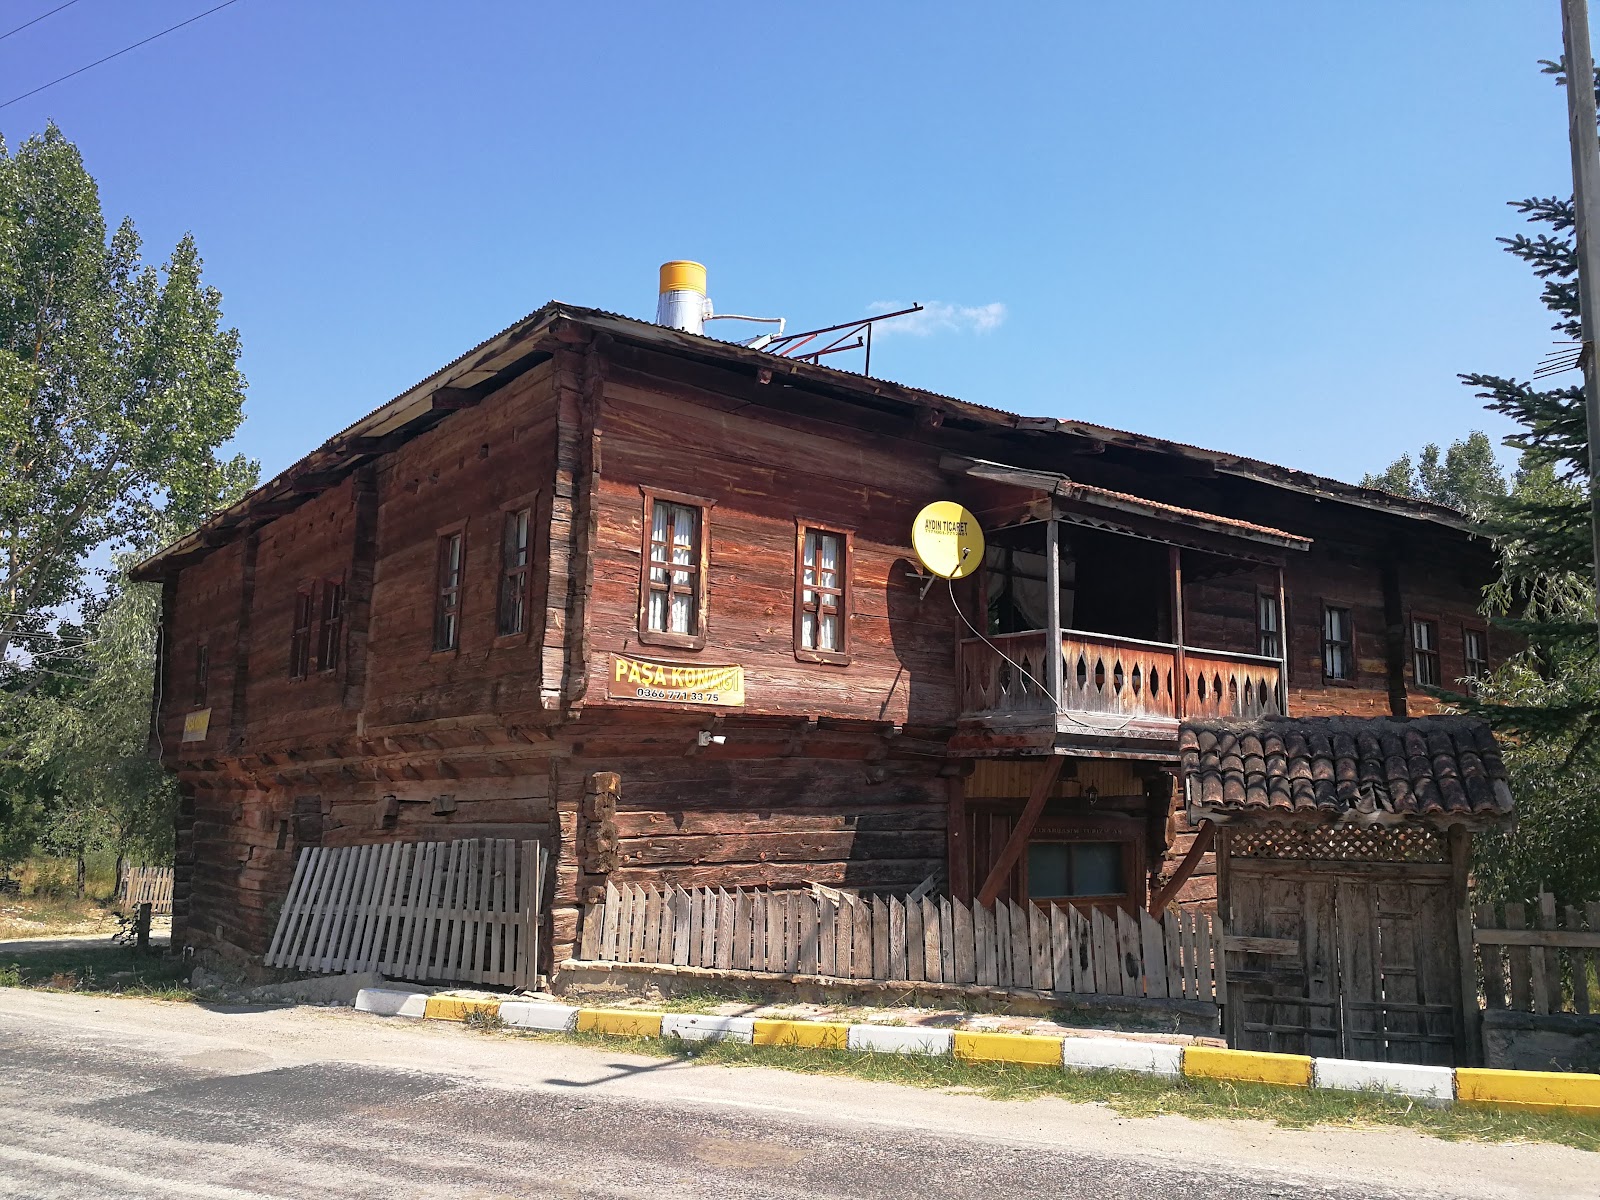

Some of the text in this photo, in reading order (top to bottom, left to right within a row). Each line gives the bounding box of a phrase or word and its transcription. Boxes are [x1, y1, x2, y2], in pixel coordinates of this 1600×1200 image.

[925, 519, 942, 530] AYDIN
[615, 659, 667, 687] PAŞA
[637, 688, 719, 702] 0366 771 33 75
